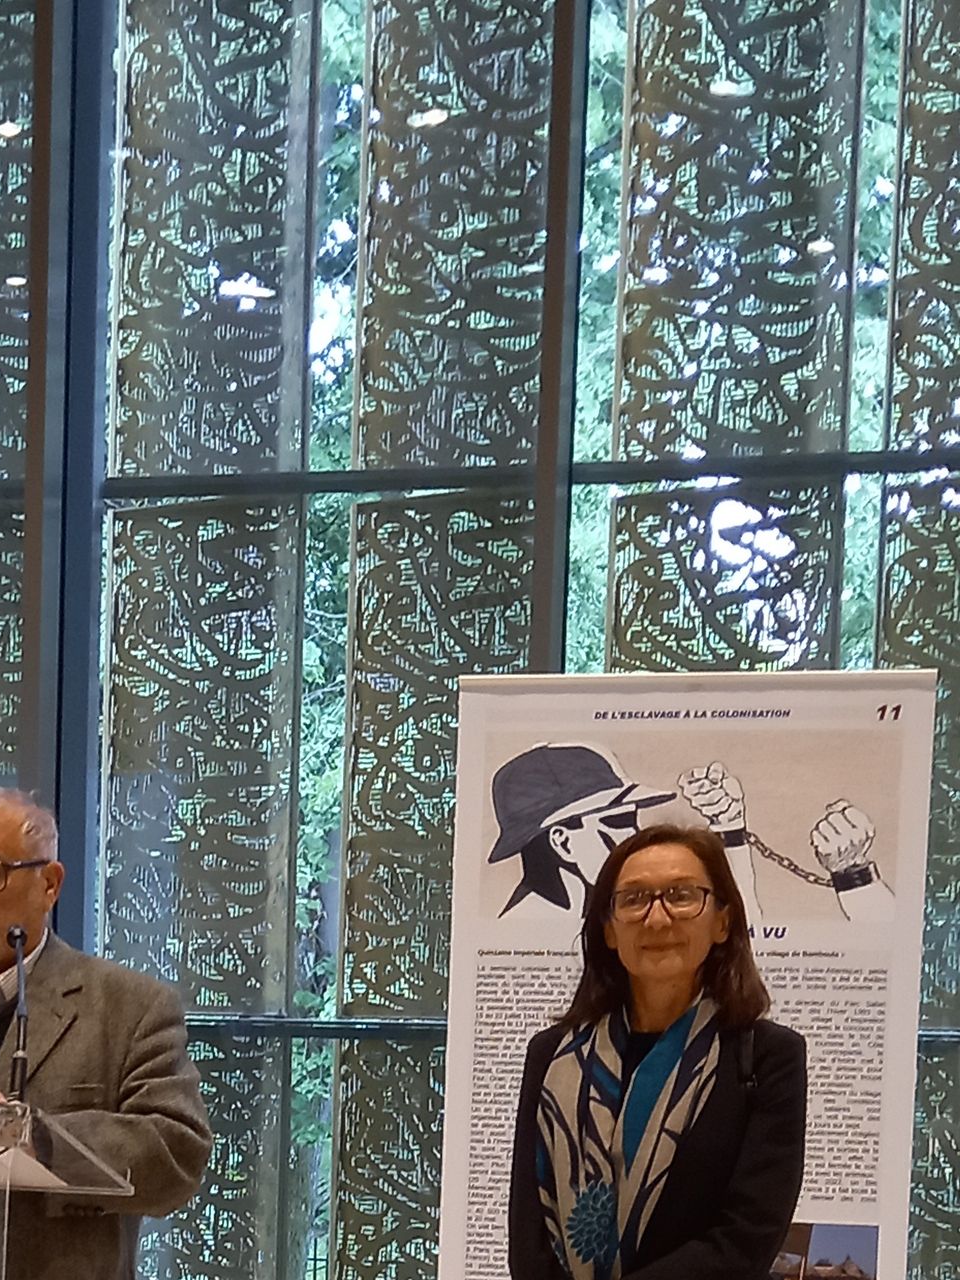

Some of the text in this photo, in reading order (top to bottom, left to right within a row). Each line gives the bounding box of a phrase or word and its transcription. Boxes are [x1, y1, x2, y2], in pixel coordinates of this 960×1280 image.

[595, 709, 791, 720] DE L'ESCLAVAGE À LA COLONISATION
[876, 704, 902, 721] 11
[763, 927, 787, 939] VU
